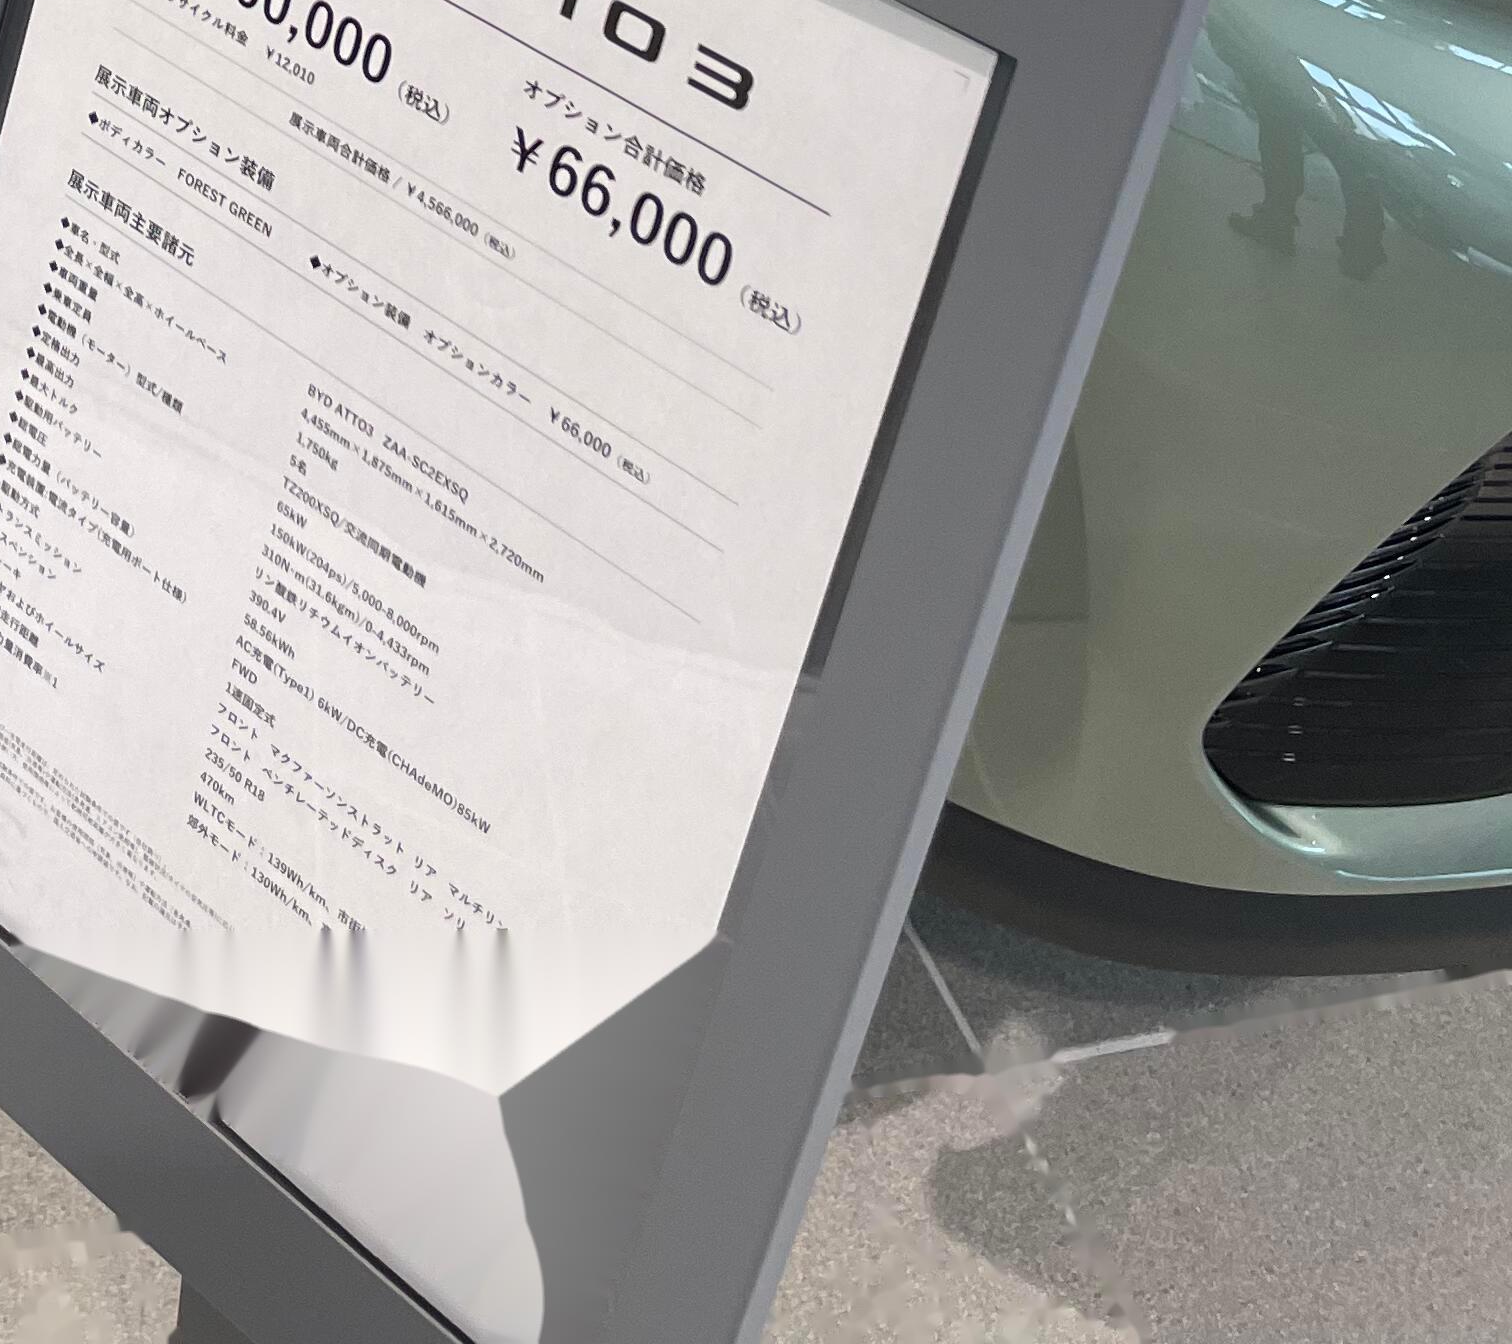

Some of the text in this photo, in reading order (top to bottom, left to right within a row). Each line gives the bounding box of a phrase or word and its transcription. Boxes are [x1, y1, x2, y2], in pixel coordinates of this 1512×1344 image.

[686, 43, 755, 111] 3
[94, 63, 276, 192] 展示車両オプション装備
[288, 111, 391, 185] 展示車両合計価格
[523, 80, 707, 198] オプション合計価格
[98, 118, 273, 239] ボディカラー FOREST GREEN
[510, 125, 733, 287] ¥66,000
[67, 168, 195, 267] 展示車両主要諸元
[321, 263, 411, 330] オプション装備
[423, 329, 532, 404] オプションカラー
[307, 383, 333, 409] BYD
[333, 403, 375, 438] ATTO3
[289, 453, 307, 477] 5名
[296, 431, 339, 472] 1,750kg
[276, 500, 308, 529] 65kW
[243, 612, 295, 661] 58.56kWh
[248, 589, 287, 624] 390.4V
[231, 657, 258, 685] FWD
[199, 771, 235, 806] 470km
[204, 747, 266, 802] 235/50 R18
[217, 702, 258, 740] フロント
[270, 743, 404, 854] マクファーソンストラット
[414, 855, 437, 877] リア
[210, 723, 251, 763] フロント
[409, 879, 433, 902] リア
